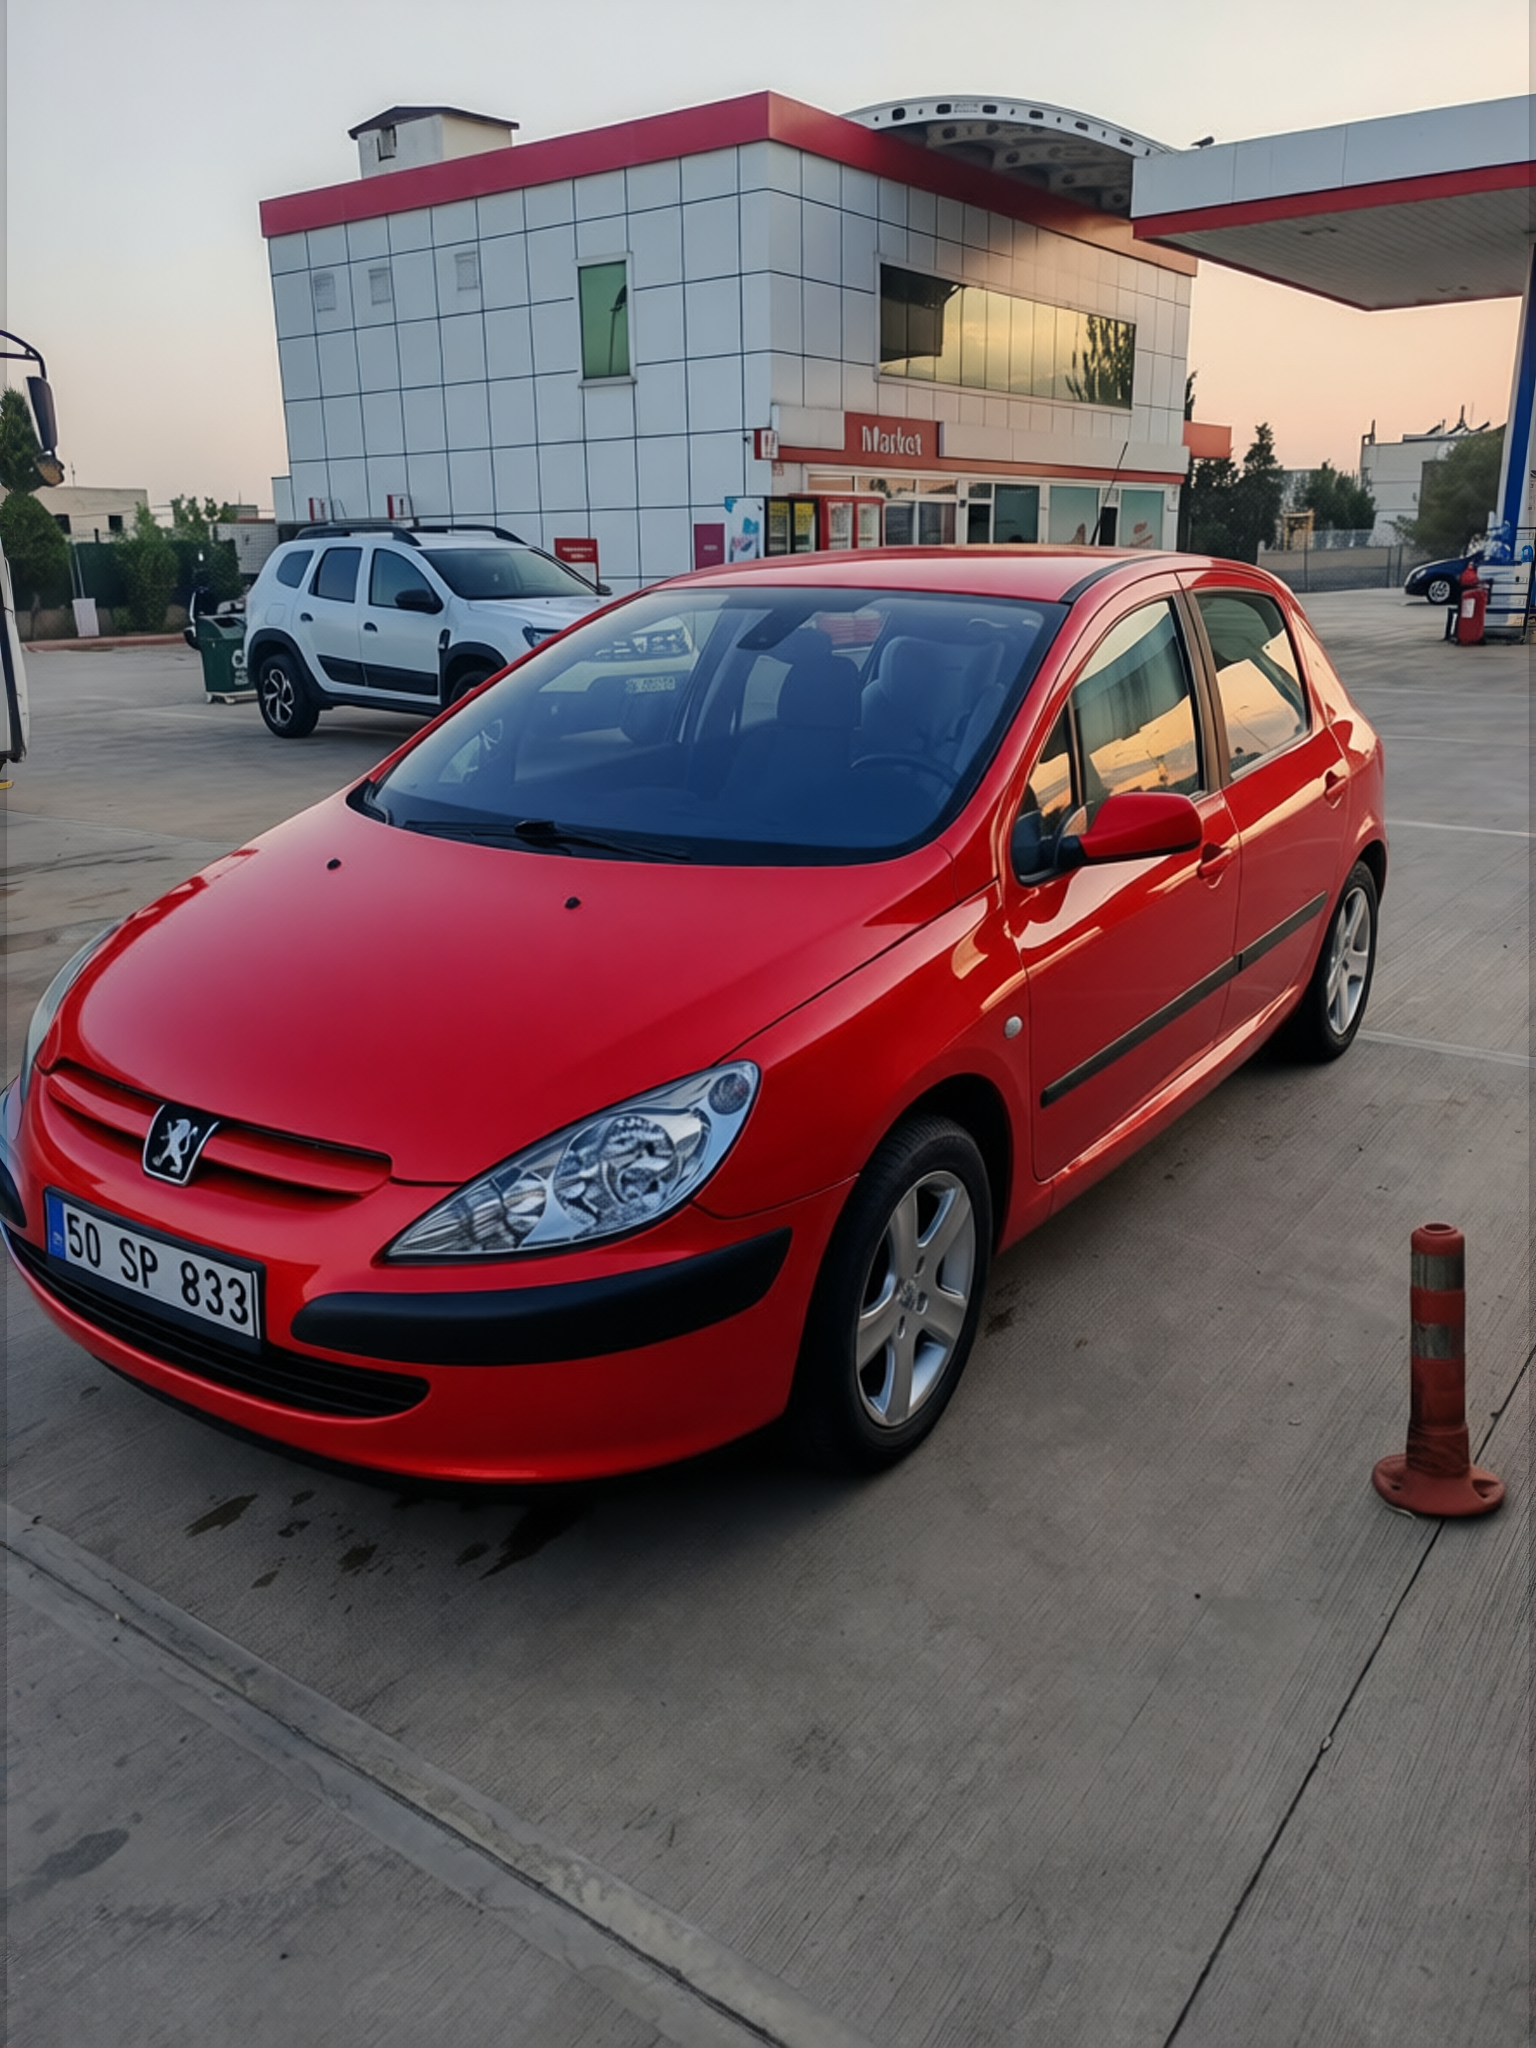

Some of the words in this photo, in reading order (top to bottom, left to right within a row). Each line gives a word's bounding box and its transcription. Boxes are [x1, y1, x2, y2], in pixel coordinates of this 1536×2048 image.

[862, 425, 922, 456] Market
[66, 1211, 101, 1269] 50
[118, 1237, 159, 1289] SP
[180, 1260, 249, 1326] 833
